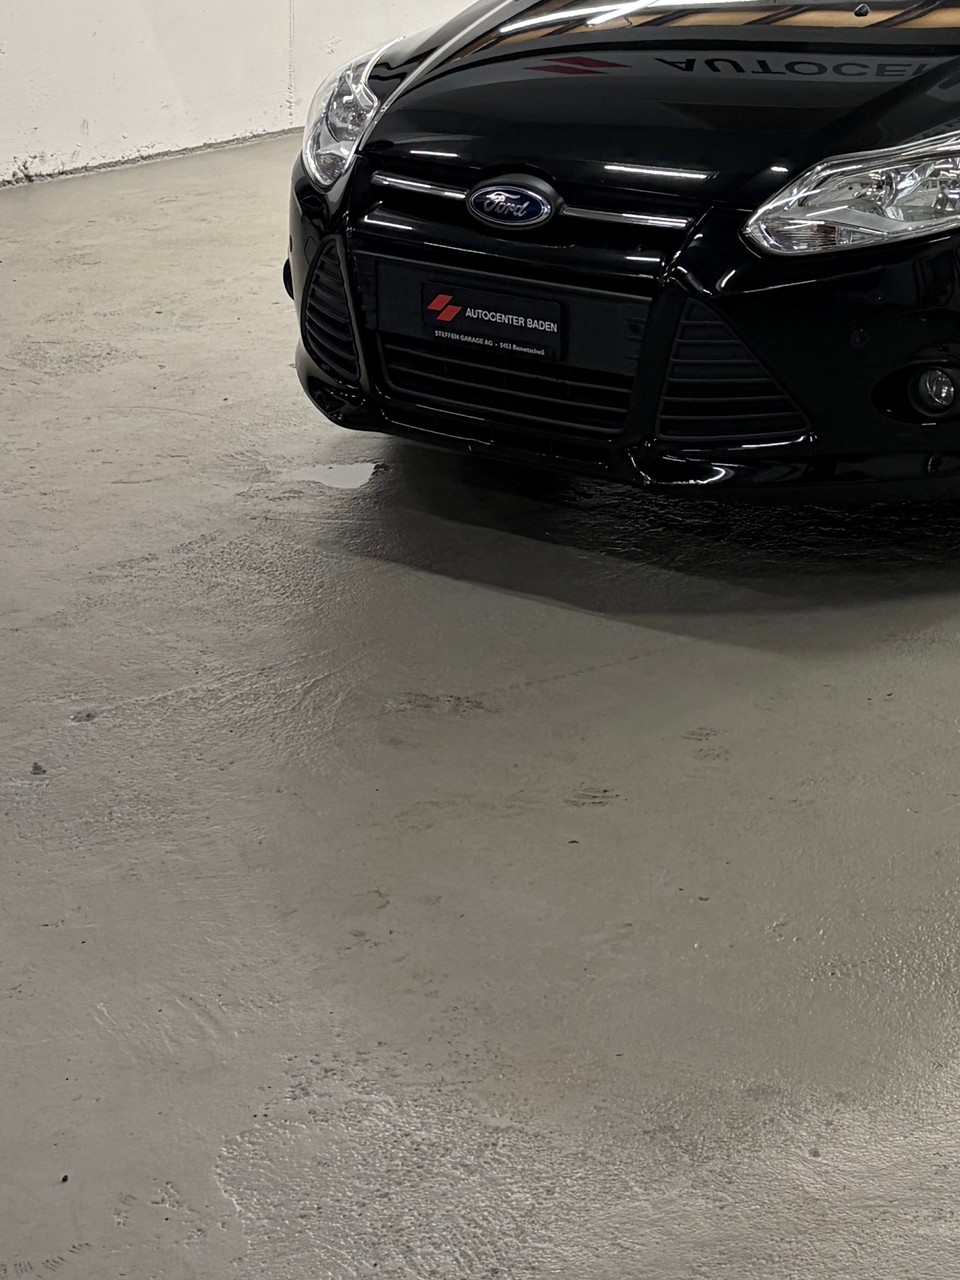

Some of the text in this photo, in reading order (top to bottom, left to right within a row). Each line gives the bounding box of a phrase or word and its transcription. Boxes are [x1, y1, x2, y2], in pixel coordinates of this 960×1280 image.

[483, 191, 530, 217] Ford
[465, 308, 558, 333] AUTOCENTER BADEN
[434, 330, 460, 340] STEFFEN
[460, 334, 483, 345] GARAGE
[484, 339, 493, 347] AG
